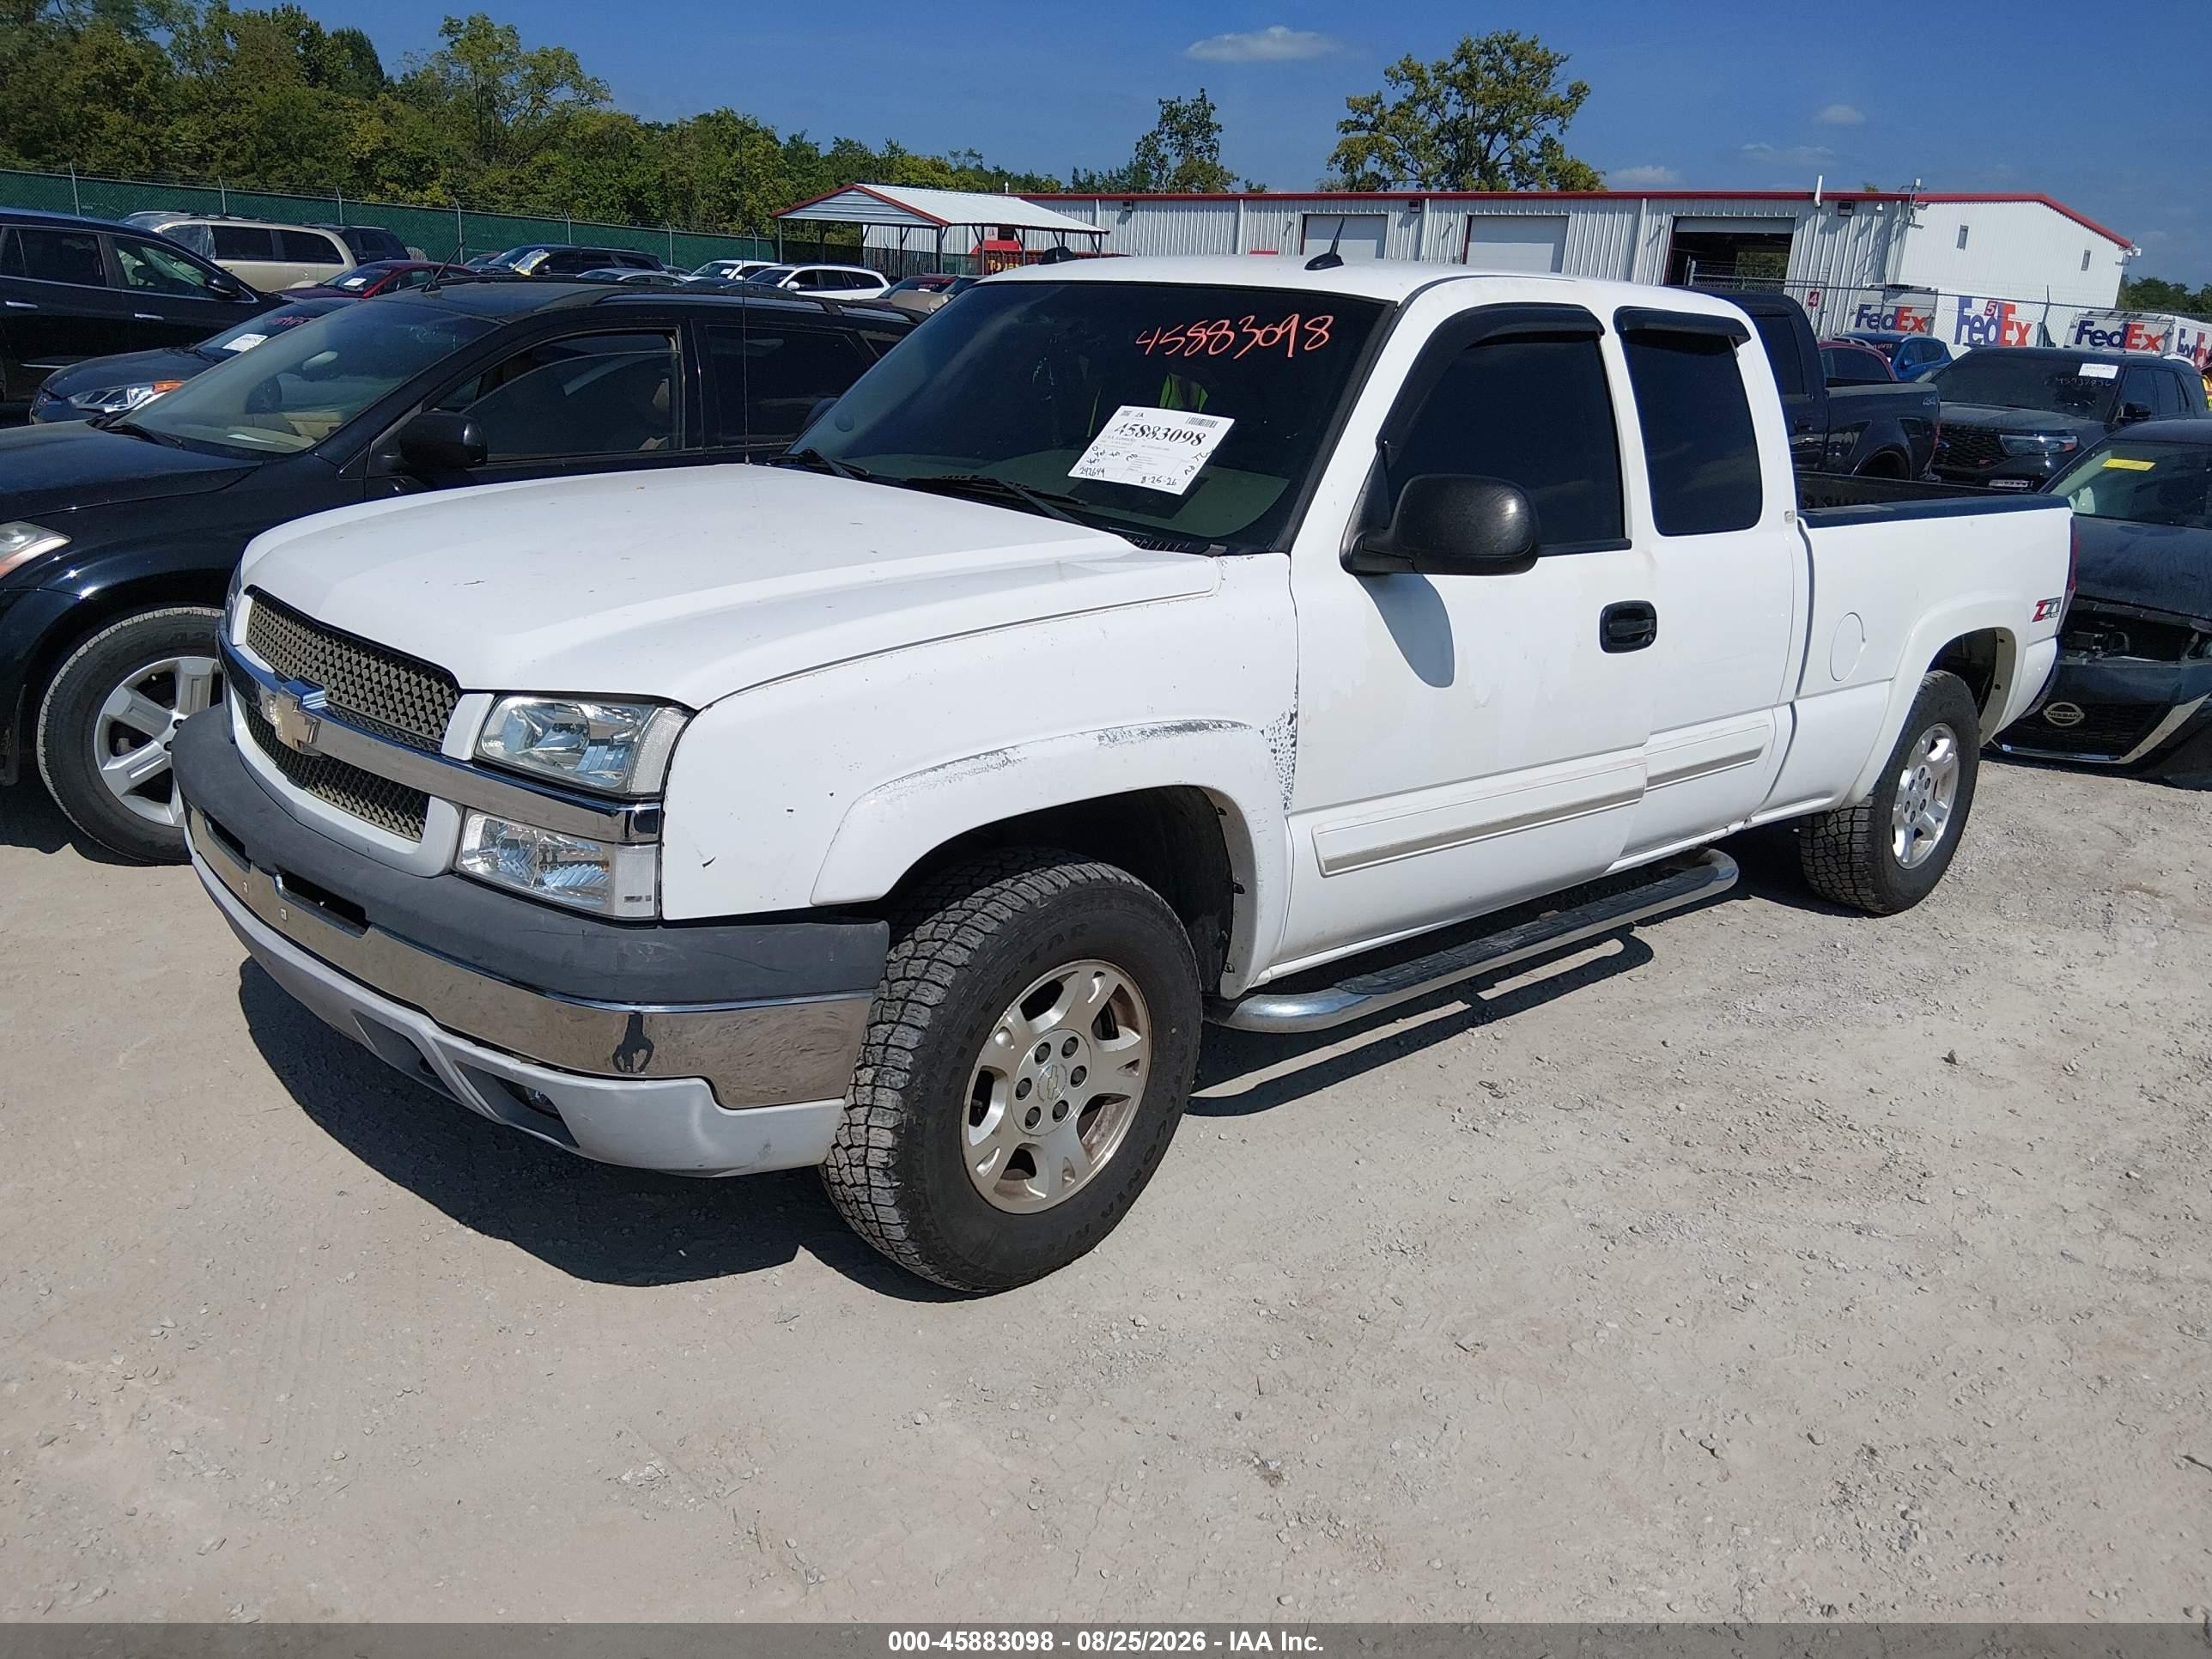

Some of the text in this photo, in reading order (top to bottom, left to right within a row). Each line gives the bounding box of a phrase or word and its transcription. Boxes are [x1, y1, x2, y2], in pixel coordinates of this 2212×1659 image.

[1809, 294, 1818, 304] 4
[1986, 302, 1996, 315] 5
[1854, 304, 1927, 333] FedEx
[1954, 297, 2033, 347] FedEx
[1135, 313, 1334, 360] 45883098
[2075, 319, 2163, 352] FedEx
[1114, 422, 1206, 447] 45883098
